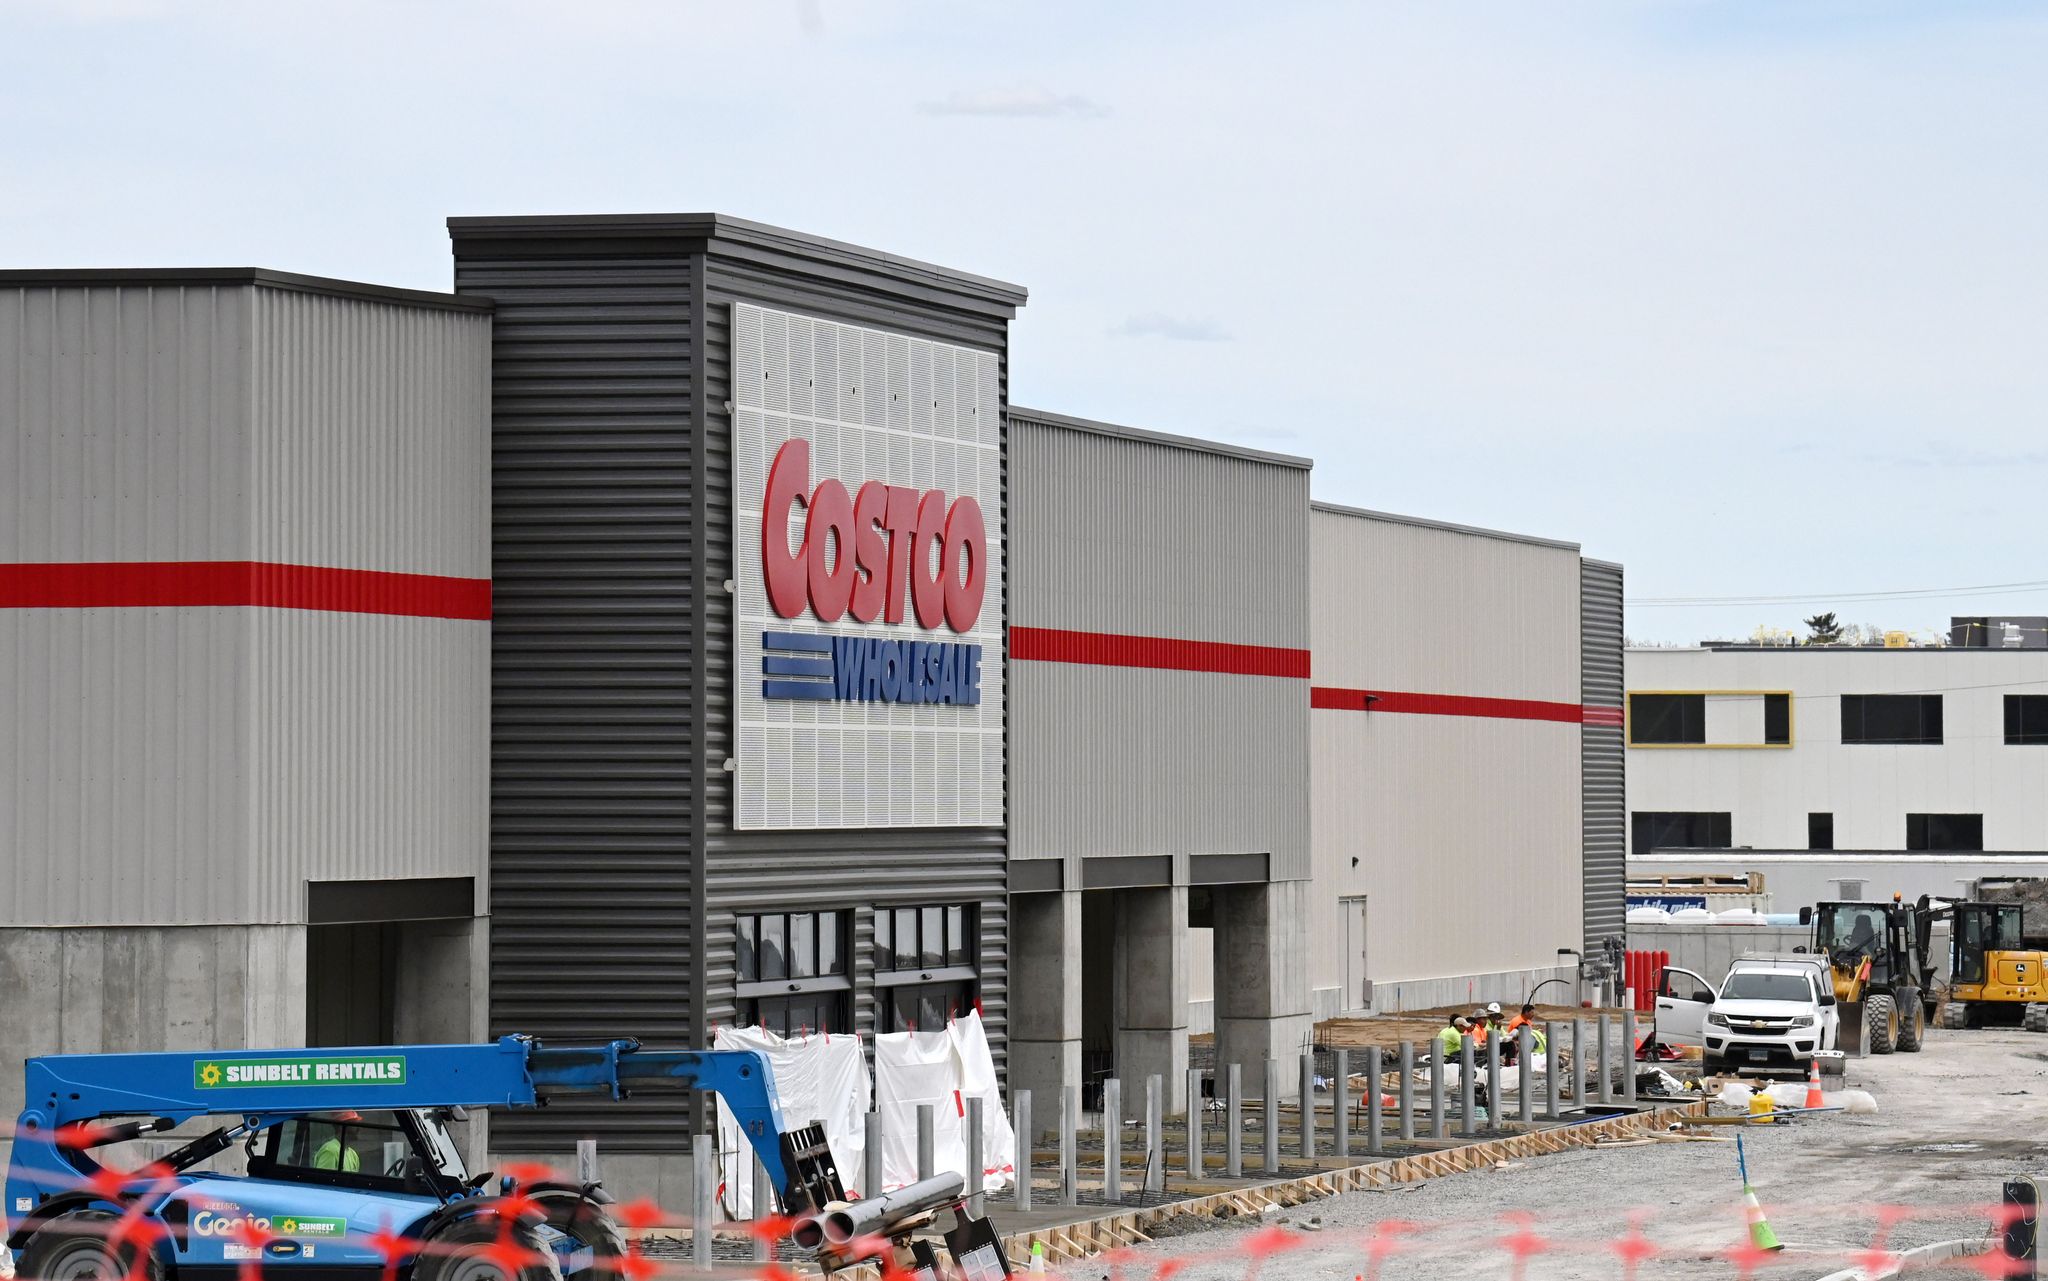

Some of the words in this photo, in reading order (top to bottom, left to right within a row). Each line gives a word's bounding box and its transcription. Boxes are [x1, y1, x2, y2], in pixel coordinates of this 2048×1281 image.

[762, 438, 987, 633] COSTCO
[832, 636, 982, 705] WHOLESALE
[226, 1064, 311, 1082] SUNBELT
[315, 1062, 401, 1080] RENTALS
[298, 1223, 336, 1231] SUNBELT
